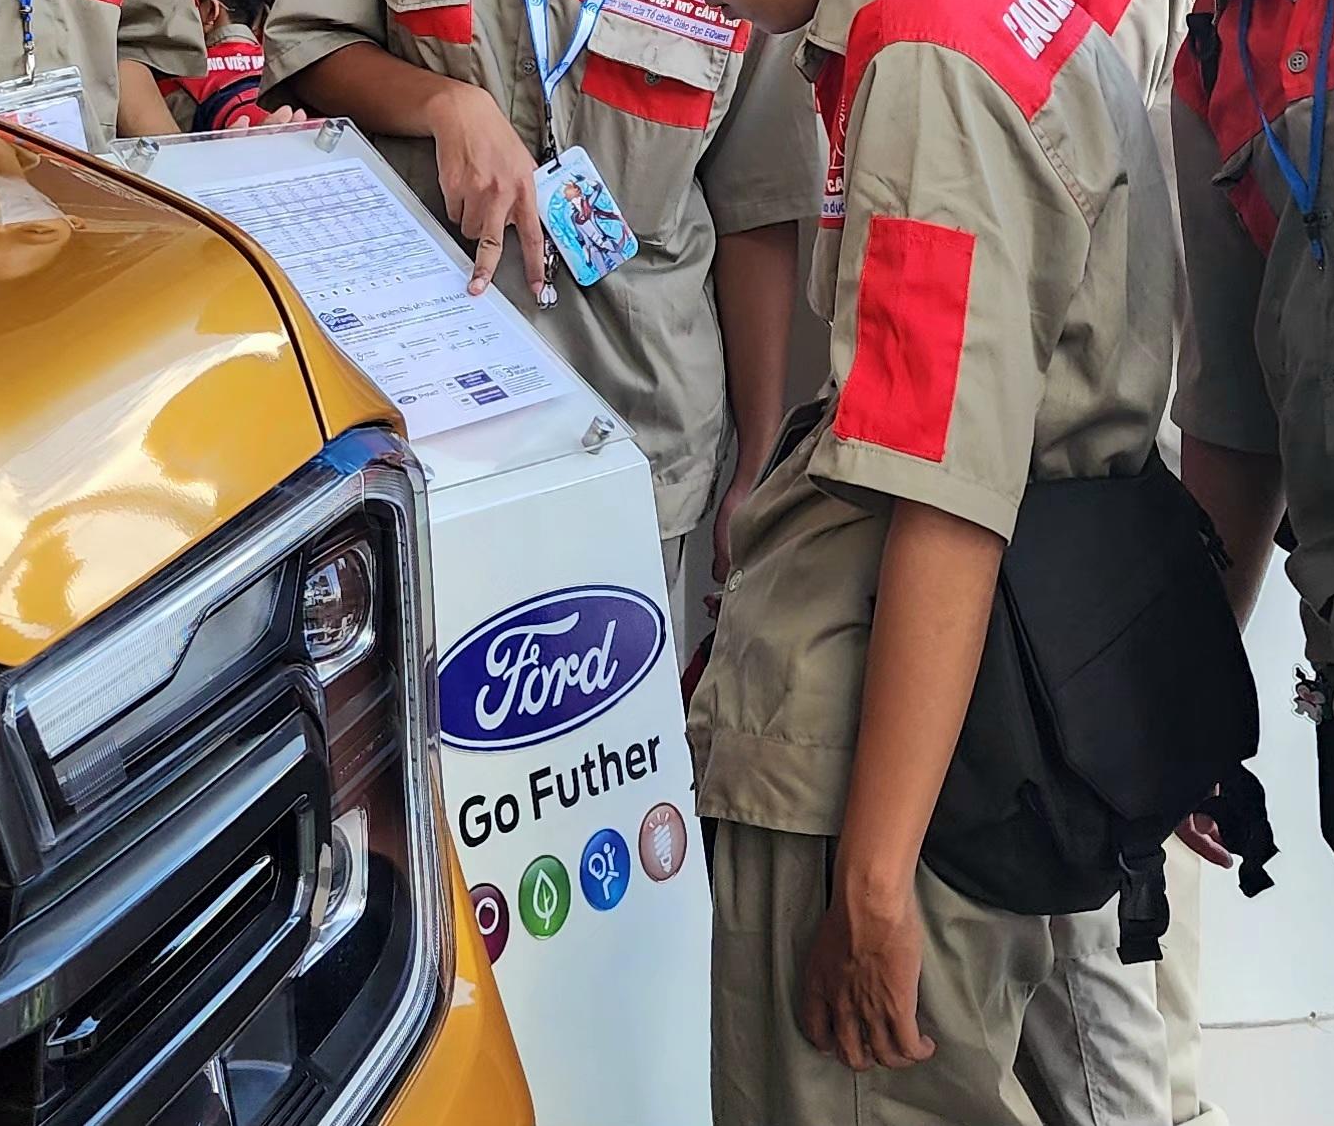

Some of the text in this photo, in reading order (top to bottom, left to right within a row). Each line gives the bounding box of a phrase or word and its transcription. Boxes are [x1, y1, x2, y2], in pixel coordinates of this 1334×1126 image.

[475, 611, 618, 730] Ford
[458, 735, 660, 848] Go Futher
